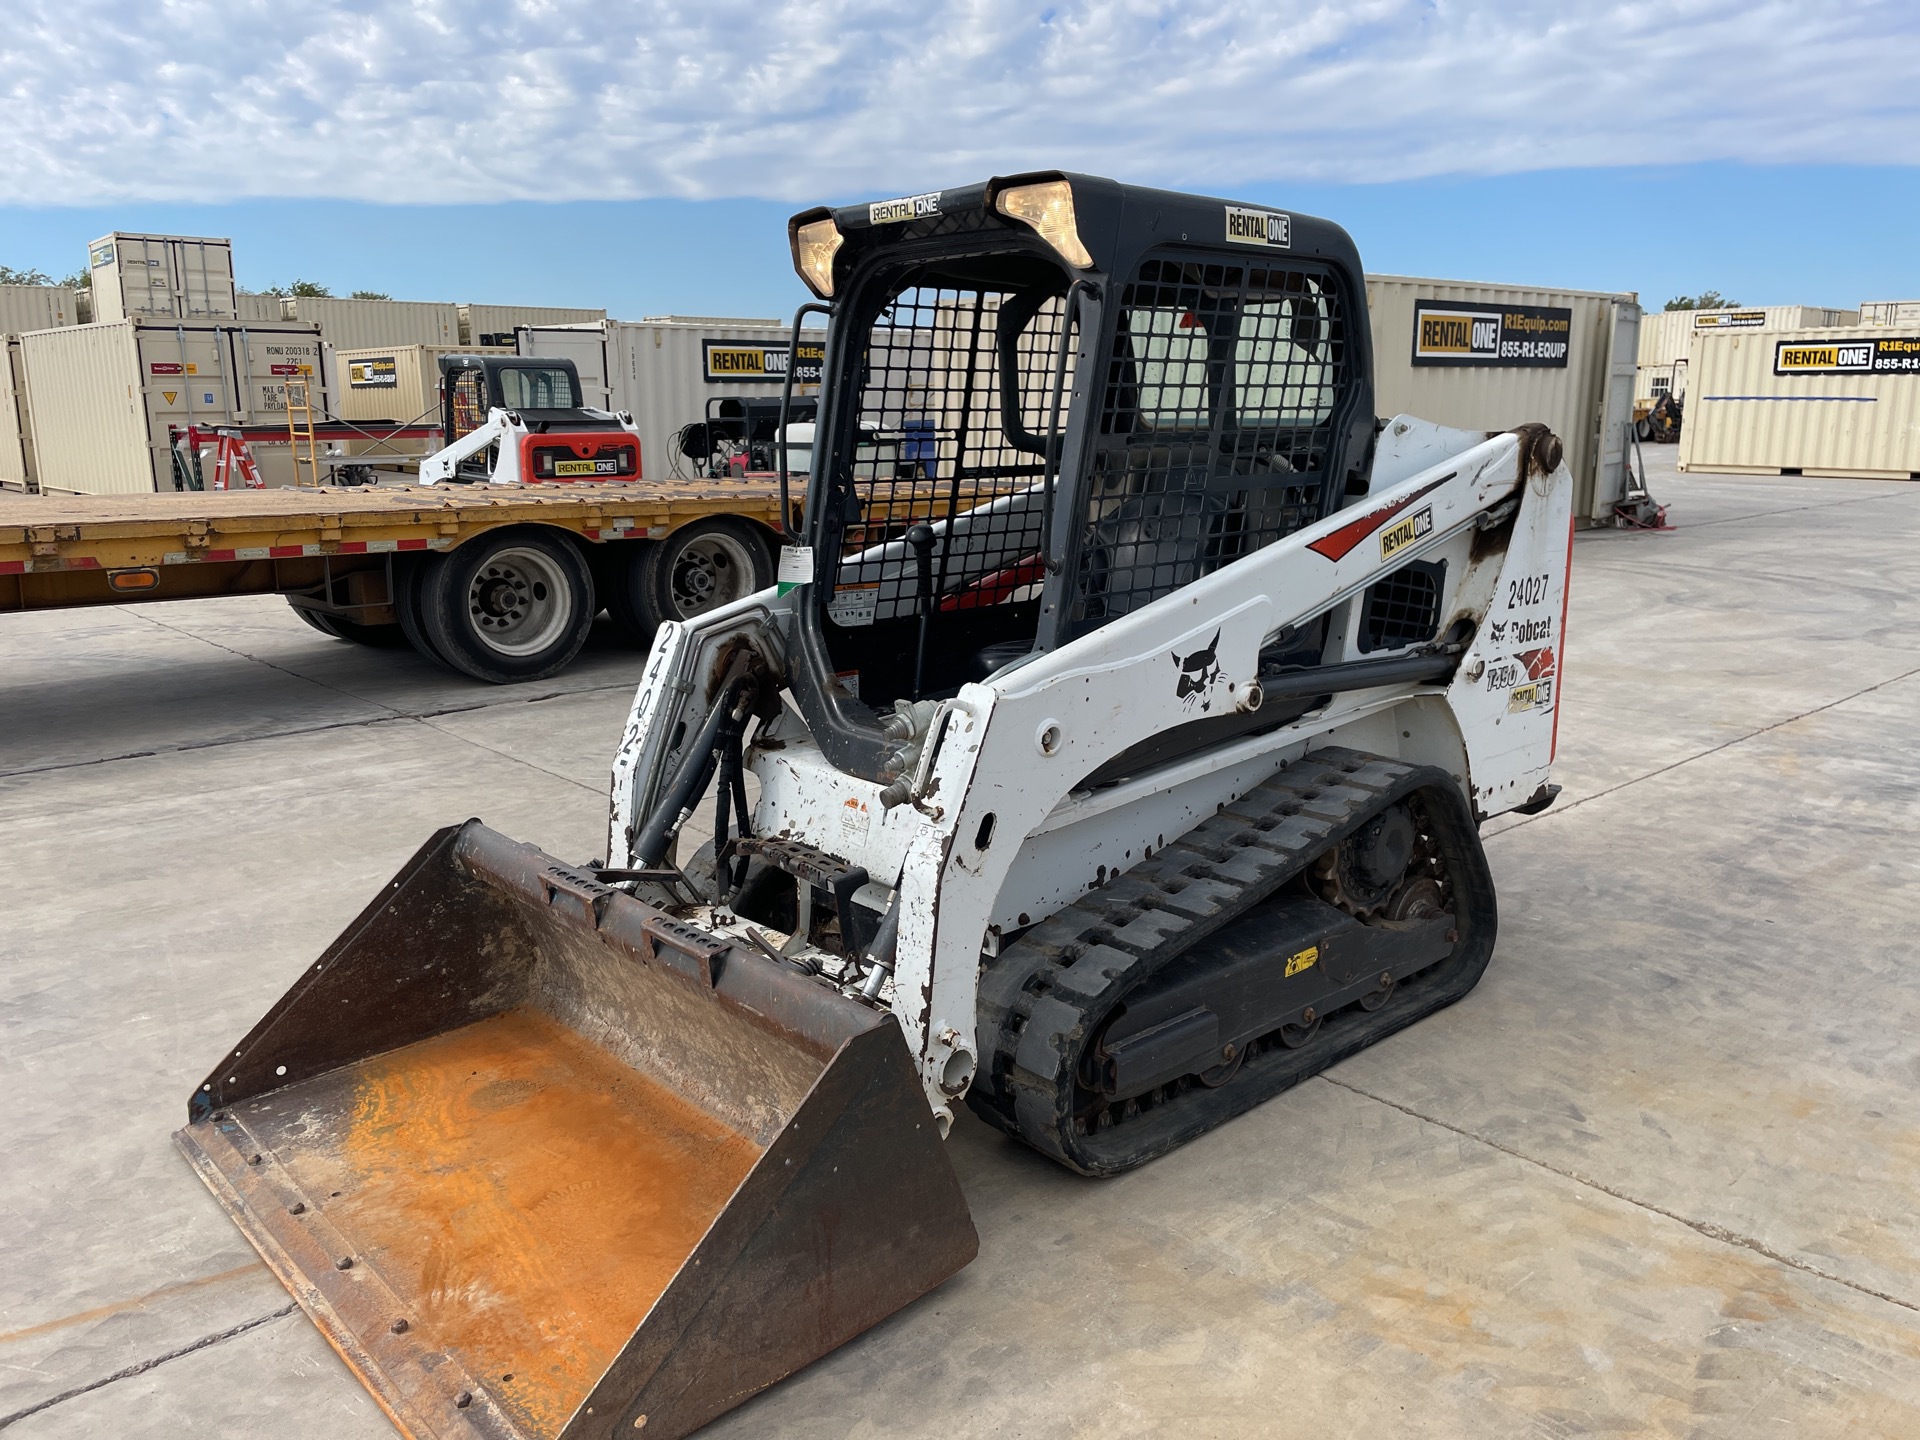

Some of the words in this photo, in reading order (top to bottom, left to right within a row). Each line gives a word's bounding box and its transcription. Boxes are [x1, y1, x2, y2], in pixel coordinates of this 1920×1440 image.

[873, 203, 912, 220] RENTAL
[916, 198, 937, 214] ONE
[1229, 213, 1266, 239] RENTAL
[1268, 219, 1288, 242] ONE
[1504, 313, 1568, 334] R1Equip.com
[1423, 320, 1469, 348] RENTAL
[1472, 321, 1497, 349] ONE
[266, 346, 284, 355] RONU
[285, 347, 310, 355] 200318
[313, 348, 318, 356] 2
[1501, 341, 1566, 359] 855-R1-EQUIP
[1783, 350, 1834, 365] RENTAL
[1838, 349, 1868, 365] ONE
[713, 352, 762, 371] RENTAL
[262, 386, 275, 394] MAX
[264, 394, 278, 402] TARE
[558, 463, 594, 473] RENTAL
[596, 462, 614, 471] ONE
[1383, 522, 1413, 555] RENTAL
[1414, 511, 1431, 536] ONE
[1508, 574, 1549, 609] 24027
[620, 623, 674, 766] 2402
[1536, 684, 1550, 702] ONE
